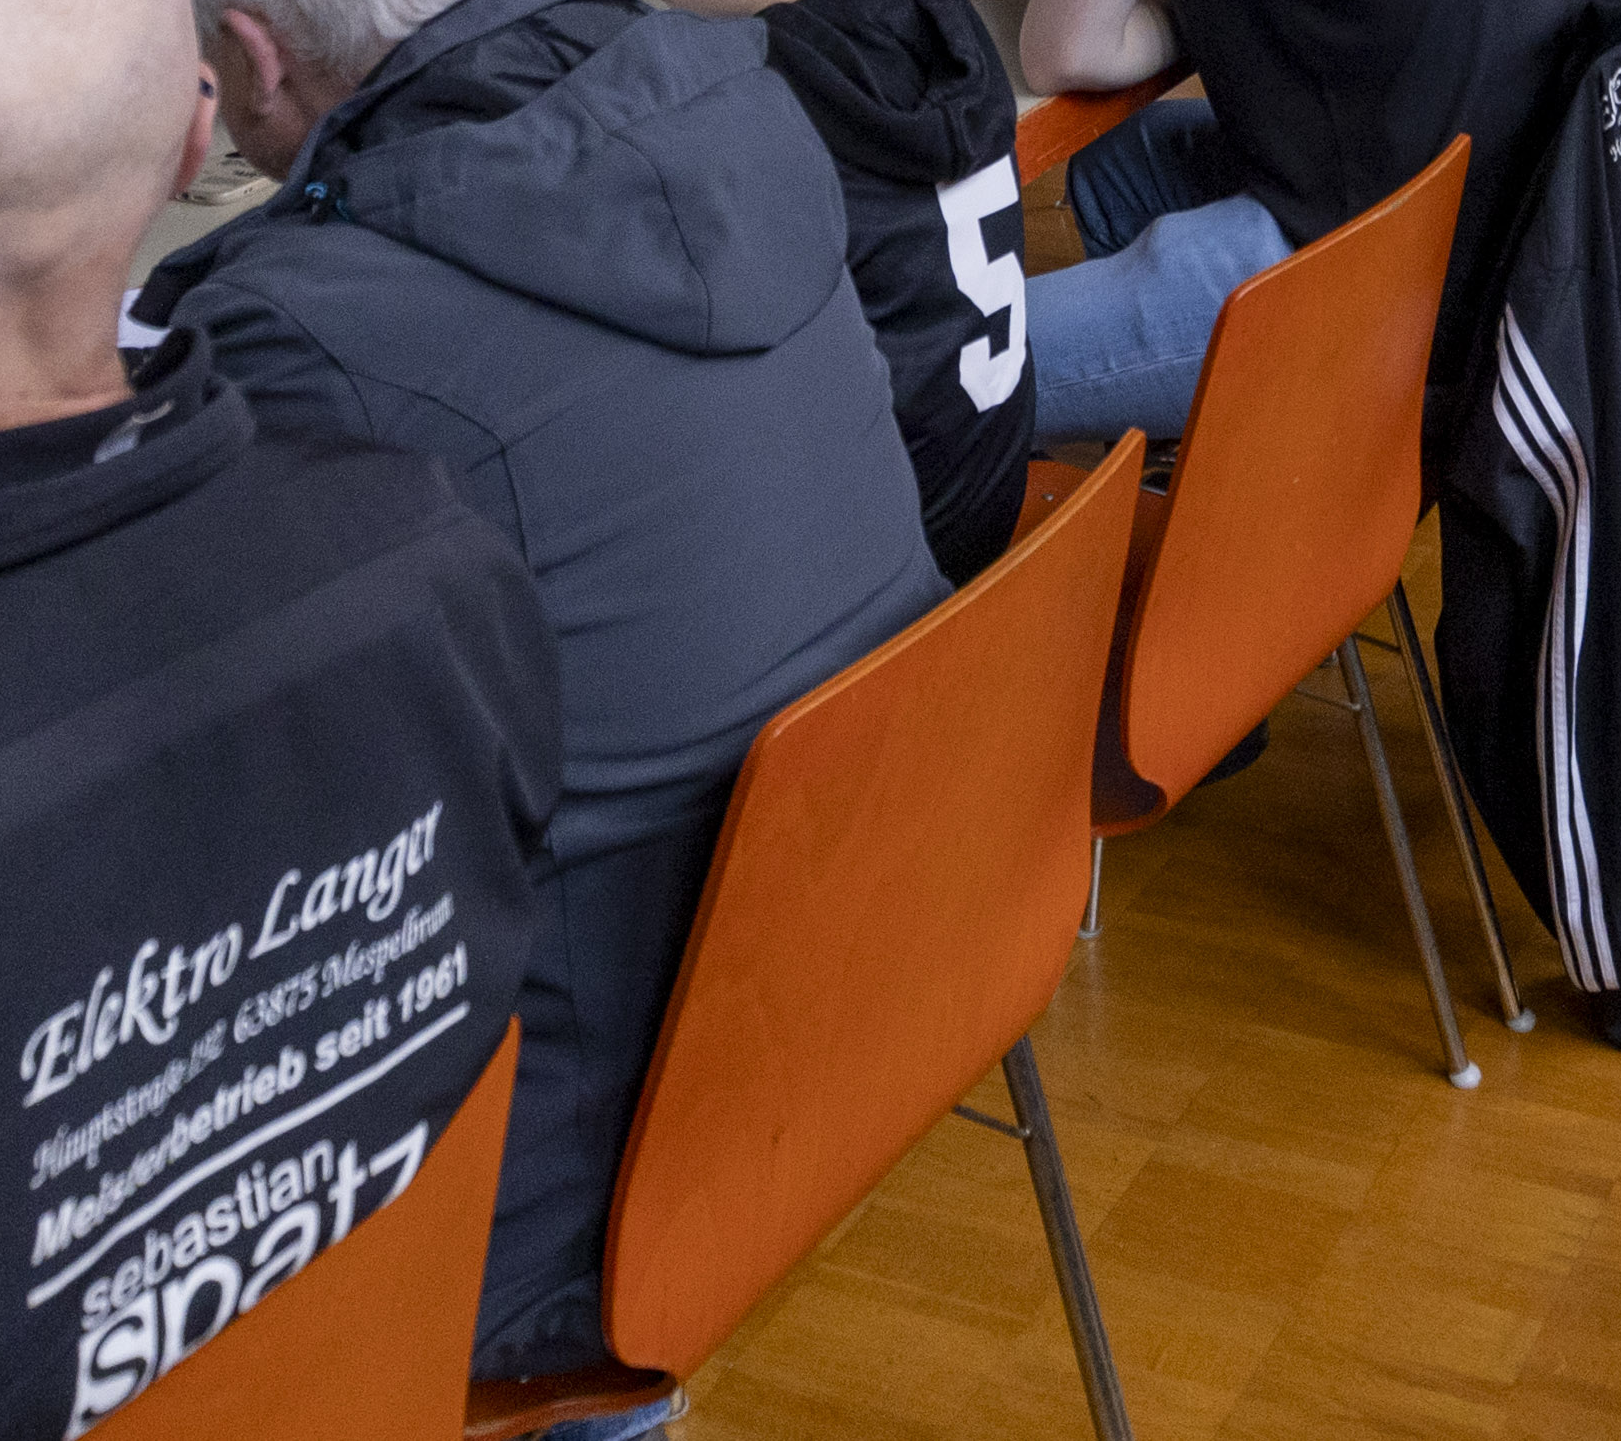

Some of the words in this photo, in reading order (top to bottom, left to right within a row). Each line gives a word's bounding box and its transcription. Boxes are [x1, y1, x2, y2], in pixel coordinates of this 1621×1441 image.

[936, 154, 1028, 412] 5
[20, 922, 243, 1109] Elektro
[247, 799, 444, 960] Langer
[233, 963, 321, 1044] 63875
[30, 1044, 307, 1267] Meisterbetrieb
[314, 994, 391, 1072] seit
[397, 940, 468, 1023] 1961
[82, 1138, 335, 1329] sebastian
